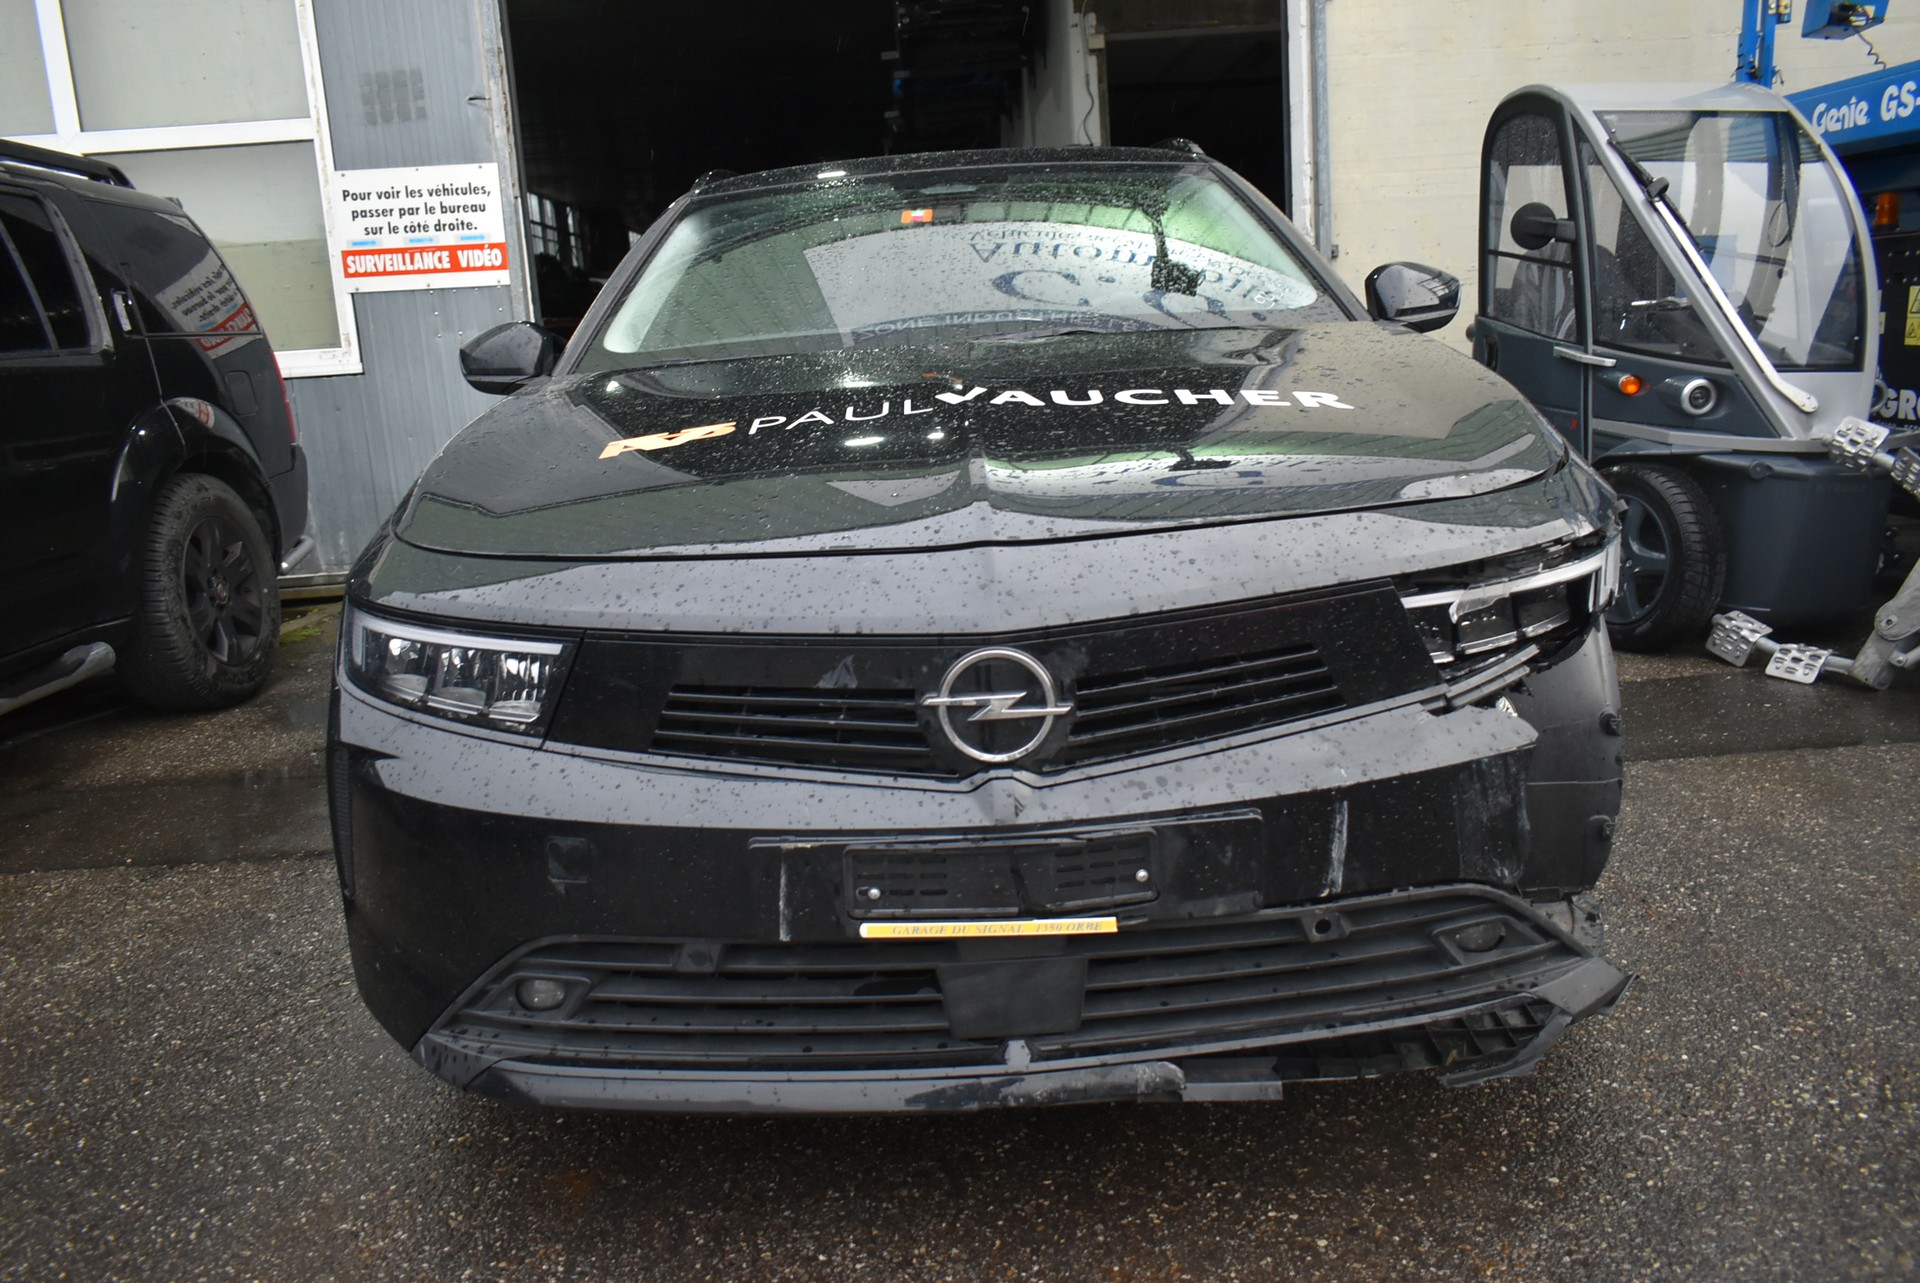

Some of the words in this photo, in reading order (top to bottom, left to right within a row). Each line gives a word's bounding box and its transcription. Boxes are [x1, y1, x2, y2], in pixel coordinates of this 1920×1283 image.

[1812, 96, 1869, 136] Genie
[342, 189, 372, 202] Pour
[375, 186, 401, 200] voir
[405, 185, 424, 198] les
[426, 182, 492, 198] véhicules,
[351, 206, 394, 221] passer
[399, 205, 421, 219] par
[424, 202, 436, 215] le
[440, 201, 486, 214] bureau
[364, 224, 384, 236] sur
[388, 221, 400, 235] le
[403, 219, 430, 234] côté
[434, 217, 478, 232] droite.
[346, 250, 450, 275] SURVEILLANCE
[457, 244, 503, 268] VIDÉO
[1879, 388, 1920, 421] GR
[892, 925, 947, 936] GARAGE
[951, 923, 969, 935] DU
[974, 923, 1025, 935] SIGNAL
[1035, 922, 1063, 933] 1350
[1065, 920, 1103, 932] ORBE
